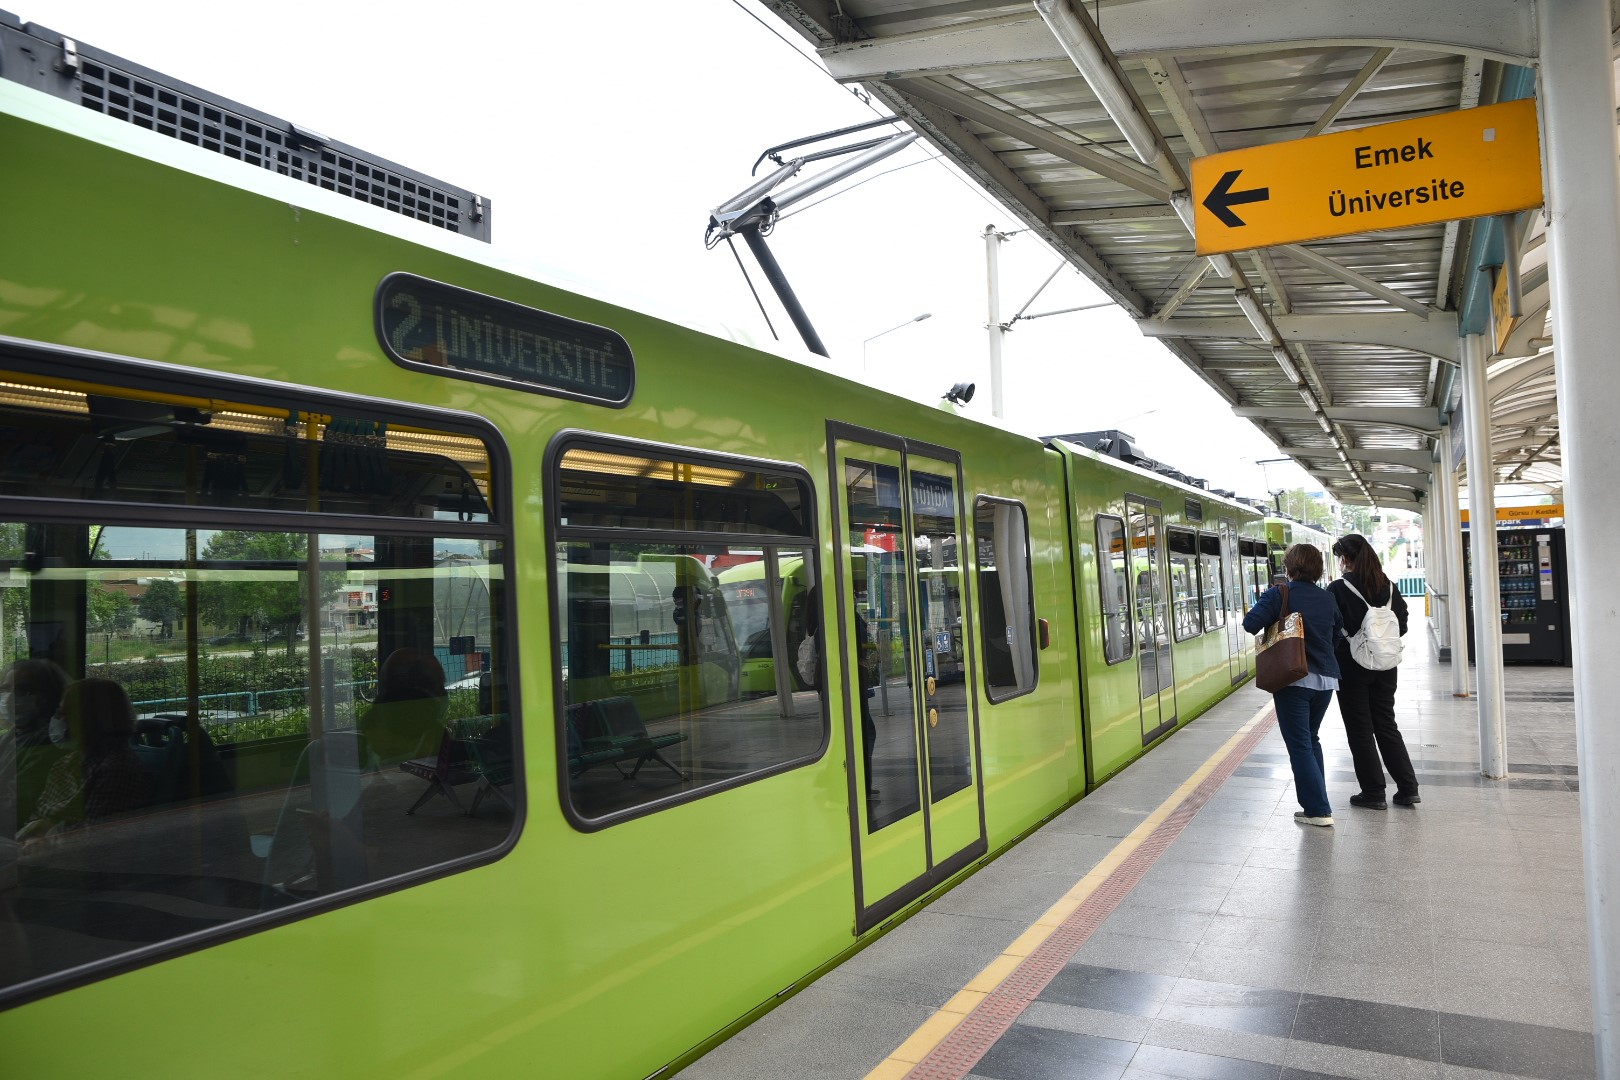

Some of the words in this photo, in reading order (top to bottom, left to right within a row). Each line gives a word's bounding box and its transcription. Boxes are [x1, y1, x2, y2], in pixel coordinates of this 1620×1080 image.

[1355, 137, 1433, 169] Emek
[1328, 178, 1465, 217] Üniversite
[391, 292, 423, 360] 2
